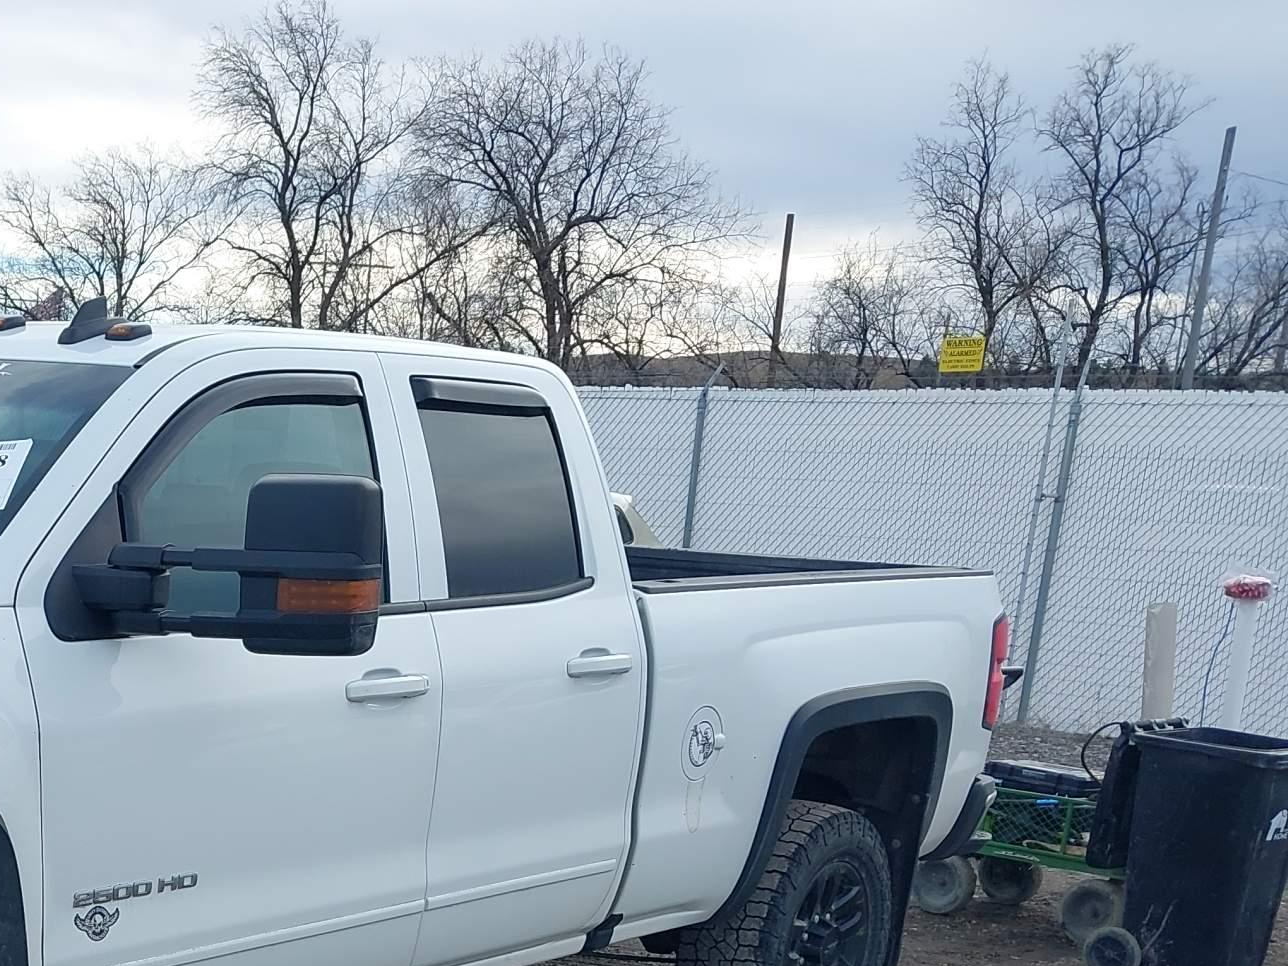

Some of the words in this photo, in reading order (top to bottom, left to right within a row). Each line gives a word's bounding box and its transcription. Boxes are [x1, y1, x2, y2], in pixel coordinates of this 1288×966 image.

[946, 339, 983, 347] WARNING
[73, 882, 153, 908] 2500
[157, 873, 198, 893] HD
